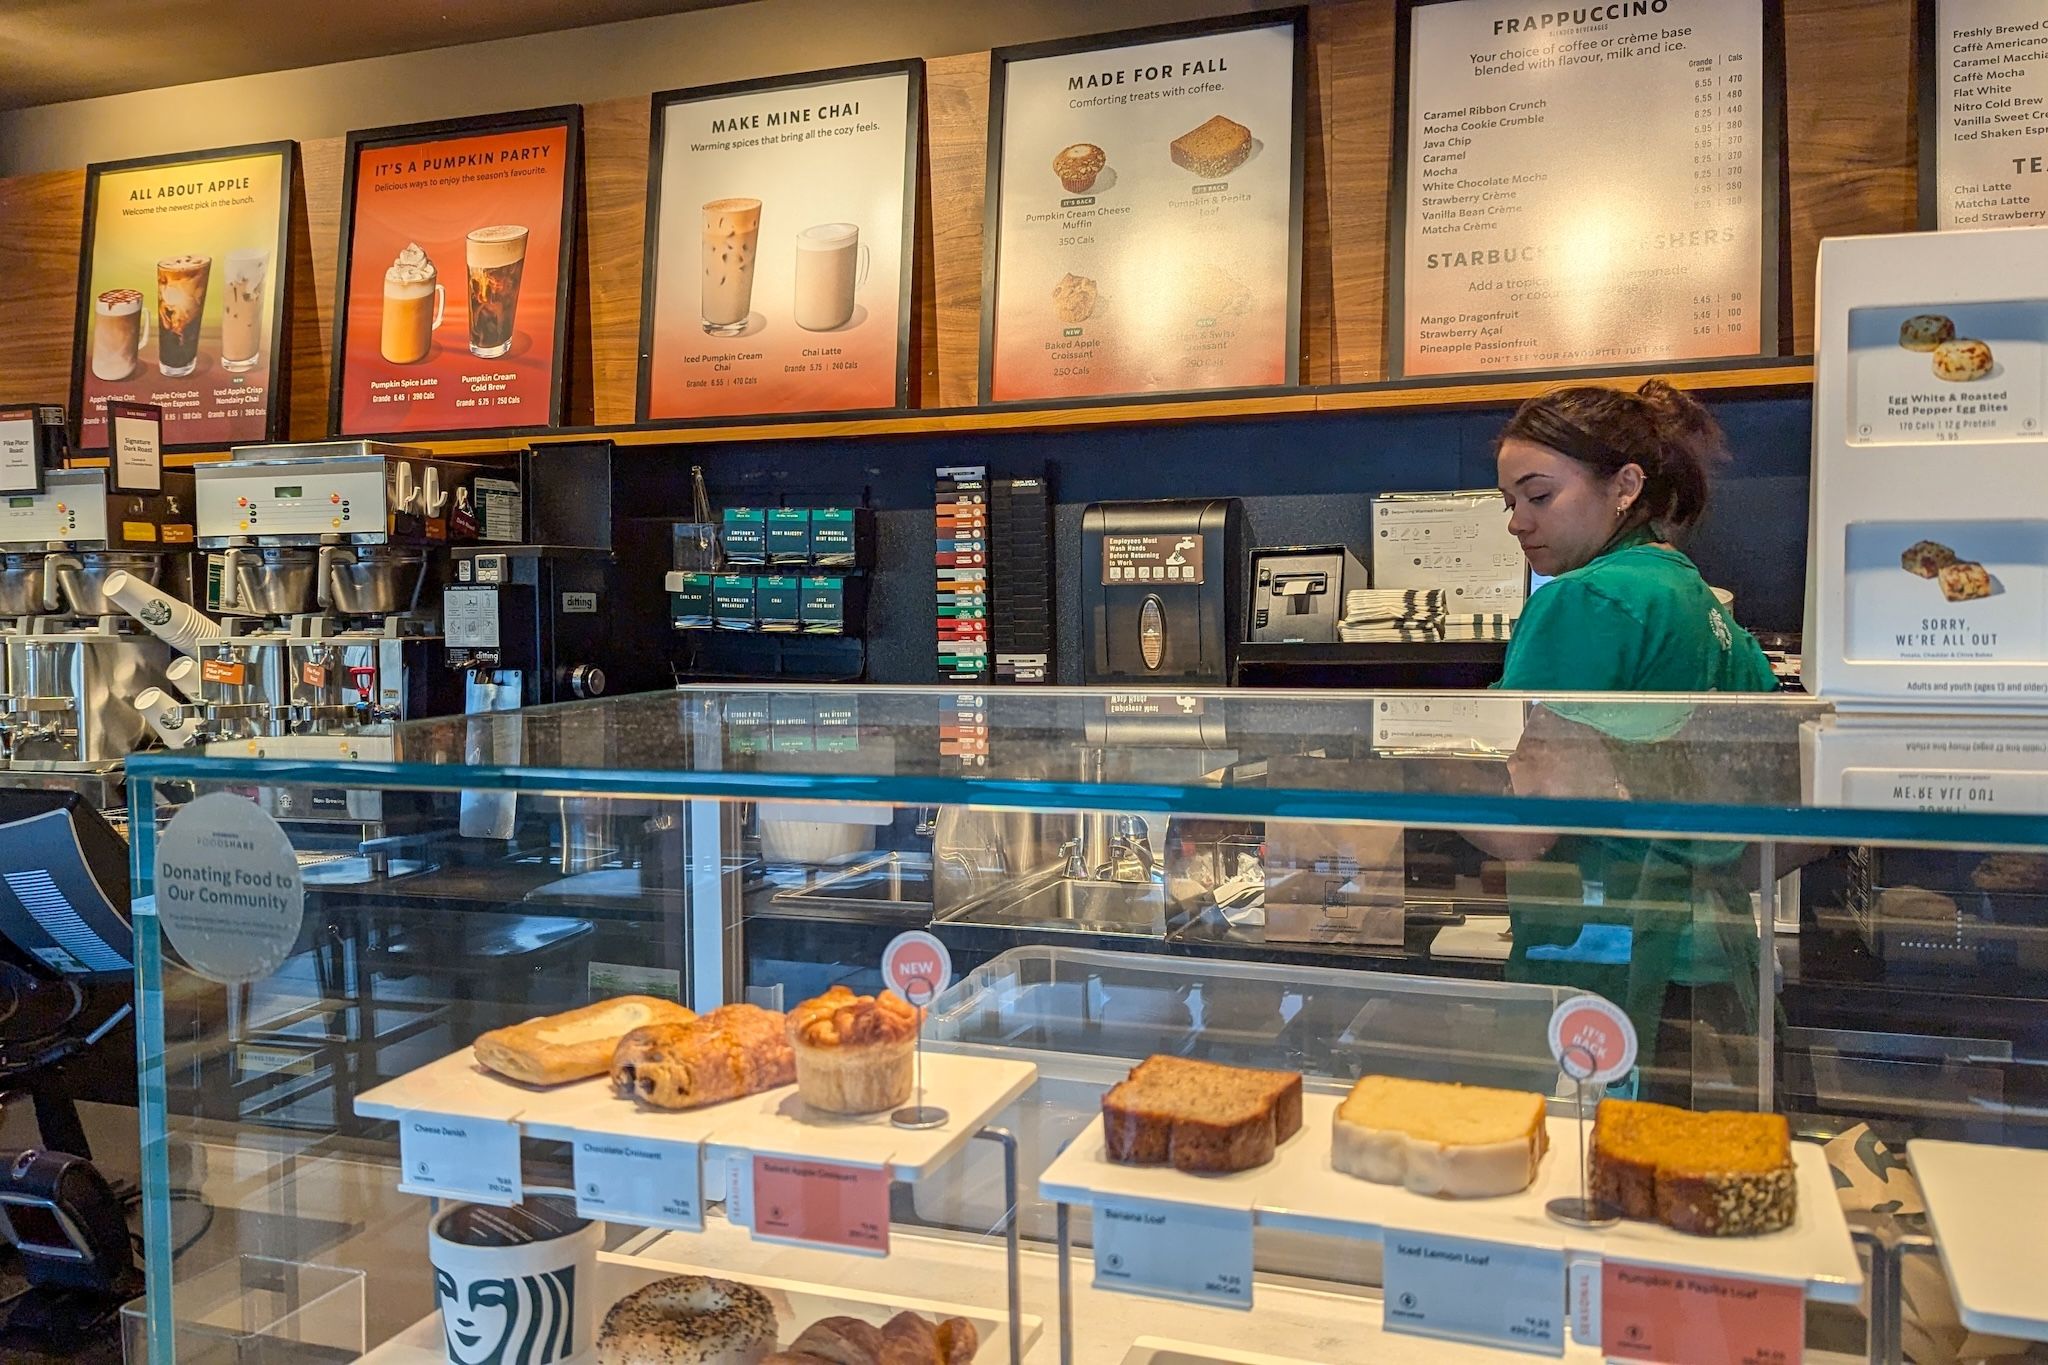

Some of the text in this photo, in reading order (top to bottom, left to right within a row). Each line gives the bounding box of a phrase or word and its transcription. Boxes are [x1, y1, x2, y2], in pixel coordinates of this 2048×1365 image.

[1494, 0, 1668, 35] FRAPPUCCINO
[1954, 21, 2038, 39] Freshly Brewed
[1470, 26, 1692, 64] Your choice of coffee or crème base
[1954, 37, 2048, 53] Caffè Americano
[1475, 41, 1686, 76] blended with flavour, milk and ice.
[1068, 58, 1227, 90] MADE FOR FALL
[1954, 68, 2025, 83] Caffè Mocha
[1070, 83, 1224, 108] Comforting treats with coffee.
[1954, 85, 2011, 97] Flat White
[1424, 100, 1546, 121] Caramel Ribbon Crunch
[1954, 97, 2043, 112] Nitro Cold Brew
[712, 102, 859, 133] MAKE MINE CHAI
[1424, 115, 1544, 135] Mocha Cookie Crumble
[691, 122, 879, 151] Warming spices that bring all the cozy feels.
[1423, 136, 1471, 149] Java Chip
[376, 146, 550, 176] IT'S A PUMPKIN PARTY
[375, 182, 408, 192] Delicious
[409, 180, 428, 189] ways
[440, 176, 460, 186] enjoy
[477, 171, 508, 180] season's
[510, 167, 547, 176] favourite.
[130, 177, 249, 200] ALL ABOUT APPLE
[122, 206, 153, 216] Welcome
[155, 205, 167, 213] the
[169, 203, 193, 212] newest
[195, 201, 209, 210] pick
[219, 198, 230, 206] the
[232, 196, 254, 205] bunch.
[1026, 206, 1130, 222] Pumpkin Cream Cheese
[1063, 220, 1092, 229] Muffin
[1059, 235, 1094, 245] 350 Cals
[1421, 310, 1518, 326] Mango Dragonfruit
[822, 347, 841, 355] Latte
[1045, 338, 1100, 350] Baked Apple
[1420, 338, 1537, 354] Pineapple Passionfruit
[684, 355, 700, 363] Iced
[702, 353, 735, 363] Pumpkin
[1052, 350, 1093, 360] Croissant
[371, 381, 400, 389] Pumpkin
[420, 378, 437, 386] Latte
[462, 373, 516, 383] Pumpkin Cream
[471, 383, 506, 392] Cold Brew
[1889, 396, 1907, 405] Egg
[1911, 394, 1945, 403] White
[1961, 392, 2007, 400] Roasted
[1888, 404, 2008, 416] Red Pepper Egg Bites
[125, 438, 150, 446] Signature
[567, 596, 592, 608] ditting
[1922, 619, 1970, 631] SORRY,
[1896, 634, 1998, 646] WE'RE ALL OUT
[476, 651, 498, 661] ditting
[1907, 682, 1931, 692] Adults
[1934, 682, 1948, 690] and
[1950, 682, 1972, 692] youth
[1974, 682, 1995, 694] (ages
[1998, 682, 2004, 691] 13
[2007, 682, 2021, 691] and
[163, 863, 292, 888] Donating Food to
[168, 885, 288, 913] Our Community
[900, 962, 933, 975] NEW
[1583, 1025, 1606, 1043] IT'S
[1572, 1035, 1607, 1058] BACK
[414, 1124, 441, 1135] Cheese
[1105, 1209, 1166, 1224] Banana Loaf
[1398, 1245, 1489, 1265] Iced Lemon Loaf
